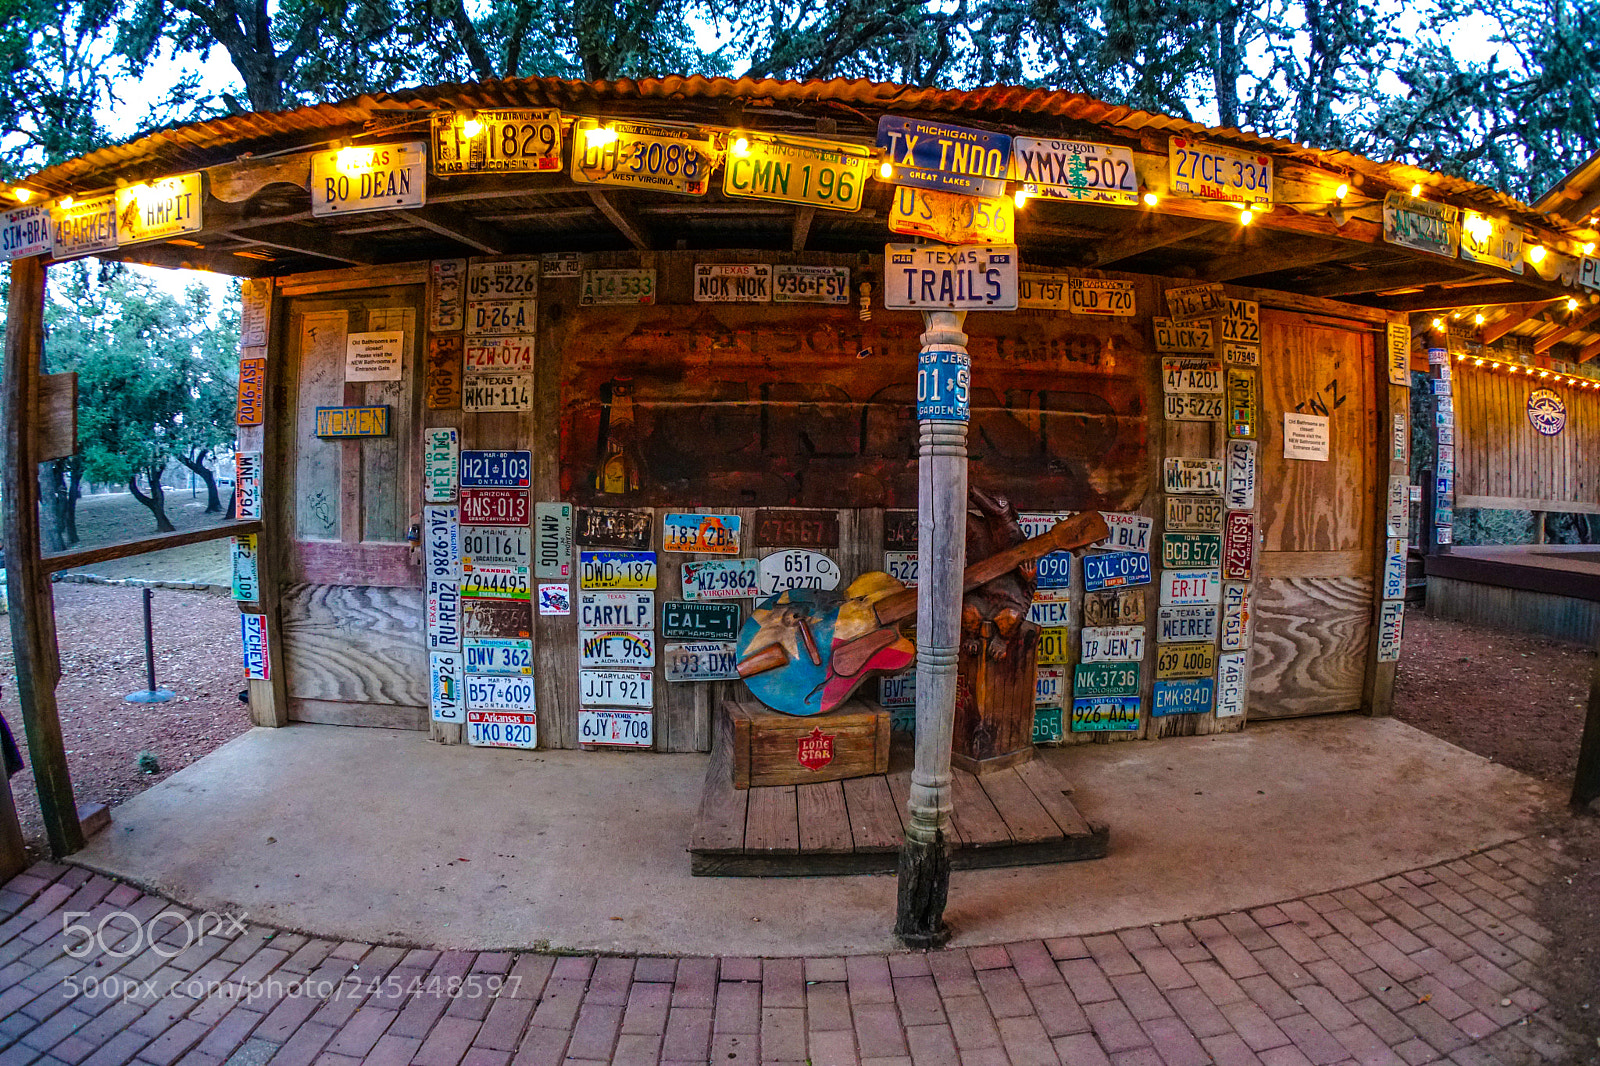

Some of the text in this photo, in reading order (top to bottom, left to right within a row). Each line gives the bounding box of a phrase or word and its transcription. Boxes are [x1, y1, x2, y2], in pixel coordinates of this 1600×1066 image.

[916, 124, 978, 142] MICHIGAN
[887, 132, 919, 168] TX
[1051, 140, 1096, 155] Oregon
[612, 173, 674, 186] WEST VIRGINIA
[910, 171, 971, 188] GREAT LAKES
[1021, 150, 1132, 191] XMX 502
[1176, 149, 1269, 194] 27CE 334
[326, 168, 412, 204] BO DEAN
[732, 160, 854, 202] CMN 196
[28, 218, 48, 246] BRA
[892, 254, 914, 264] MAR
[926, 250, 978, 265] TEXAS
[719, 266, 750, 276] TEXAS
[796, 267, 831, 275] Minnesota
[470, 274, 534, 295] US 5226
[700, 277, 767, 298] NOK NOK
[778, 276, 847, 296] 936 FSV
[903, 268, 1002, 302] TRAILS
[1038, 282, 1064, 302] 757
[1073, 290, 1132, 310] CLD 720
[1230, 301, 1252, 321] ML
[362, 338, 388, 346] Bathrooms
[1393, 326, 1405, 370] HIGHAM
[920, 354, 938, 364] NEW
[484, 376, 514, 386] TEXAS
[240, 361, 257, 422] 2046-ASE
[465, 387, 529, 406] WKH 114
[920, 406, 954, 416] GARDEN
[1168, 398, 1222, 418] US 5226
[319, 408, 386, 436] WOMEN
[464, 459, 528, 479] H21 103
[1182, 461, 1208, 470] TEXAS
[1167, 470, 1221, 489] WKH 114
[464, 498, 526, 518] 4NS 013
[1196, 504, 1221, 523] 692
[1392, 484, 1403, 530] SET UP
[1106, 514, 1134, 524] TEXAS
[432, 510, 450, 576] ZAC-9286
[451, 524, 459, 562] VIRGINIA
[542, 515, 559, 568] 4MYDOG
[671, 525, 698, 546] 183
[1120, 528, 1148, 548] BLK
[464, 536, 526, 556] 80116 L
[1166, 542, 1218, 560] BCB 572
[1230, 515, 1248, 577] BSD 279
[628, 562, 653, 582] 187
[784, 555, 811, 573] 651
[703, 590, 741, 598] VIRGINIA
[430, 599, 438, 628] TEXAS
[584, 606, 647, 626] CARYL P
[1226, 588, 1244, 646] 2FLY513
[688, 631, 734, 639] HAMPSHIRE
[1163, 618, 1213, 638] WEEREE
[248, 617, 264, 678] 57CHEVY
[584, 638, 652, 659] NVE 963
[684, 644, 721, 652] NEVADA
[1104, 639, 1128, 657] JEN
[468, 648, 532, 668] DWV 362
[1158, 654, 1179, 672] 639
[440, 657, 456, 719] CVP 926
[470, 684, 532, 703] B57 609
[586, 680, 646, 700] JJT 921
[1157, 690, 1179, 708] EMK
[483, 712, 521, 724] Arkansas
[614, 712, 632, 720] YORK
[1076, 705, 1137, 724] 926 AAJ
[506, 724, 532, 744] 820
[583, 720, 648, 739] 6JY 708
[802, 740, 830, 750] LONE
[800, 750, 830, 761] STAR
